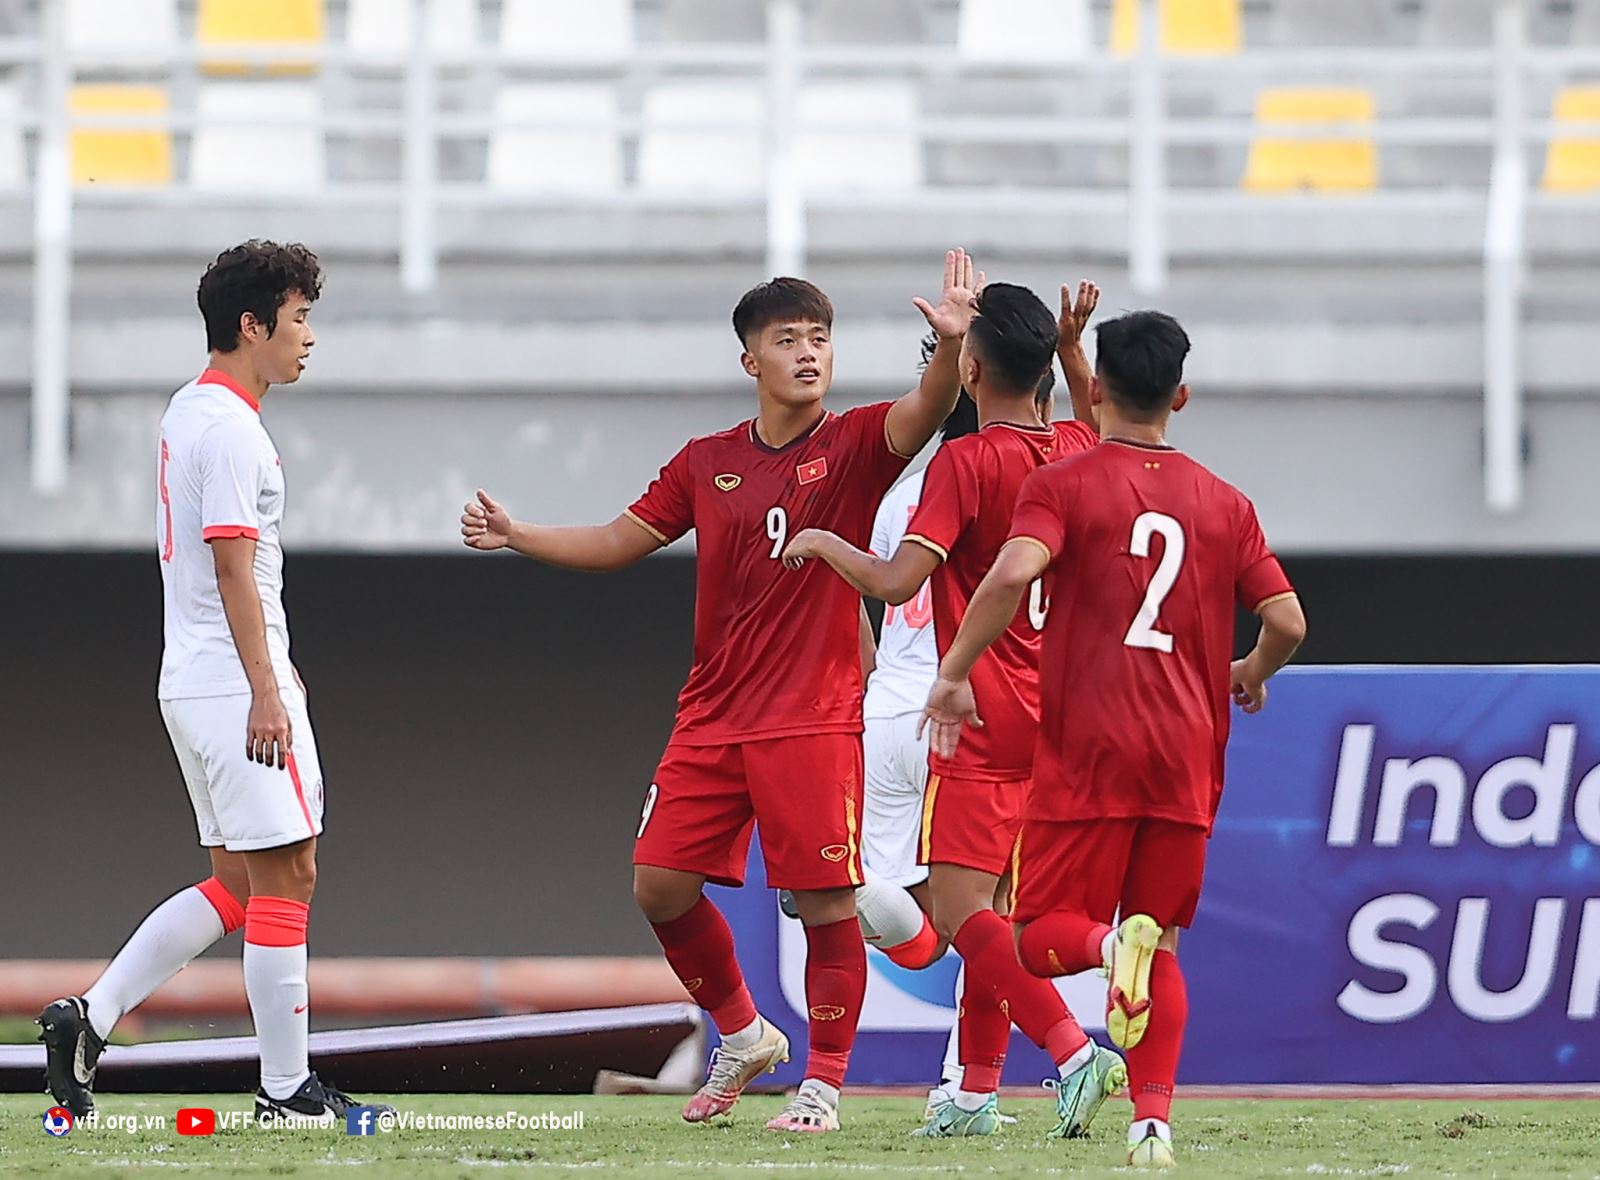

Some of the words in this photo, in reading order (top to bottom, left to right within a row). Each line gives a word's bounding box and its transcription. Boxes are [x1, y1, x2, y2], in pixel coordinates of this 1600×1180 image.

[766, 506, 787, 559] 9
[1123, 511, 1186, 654] 2
[636, 783, 658, 839] 9
